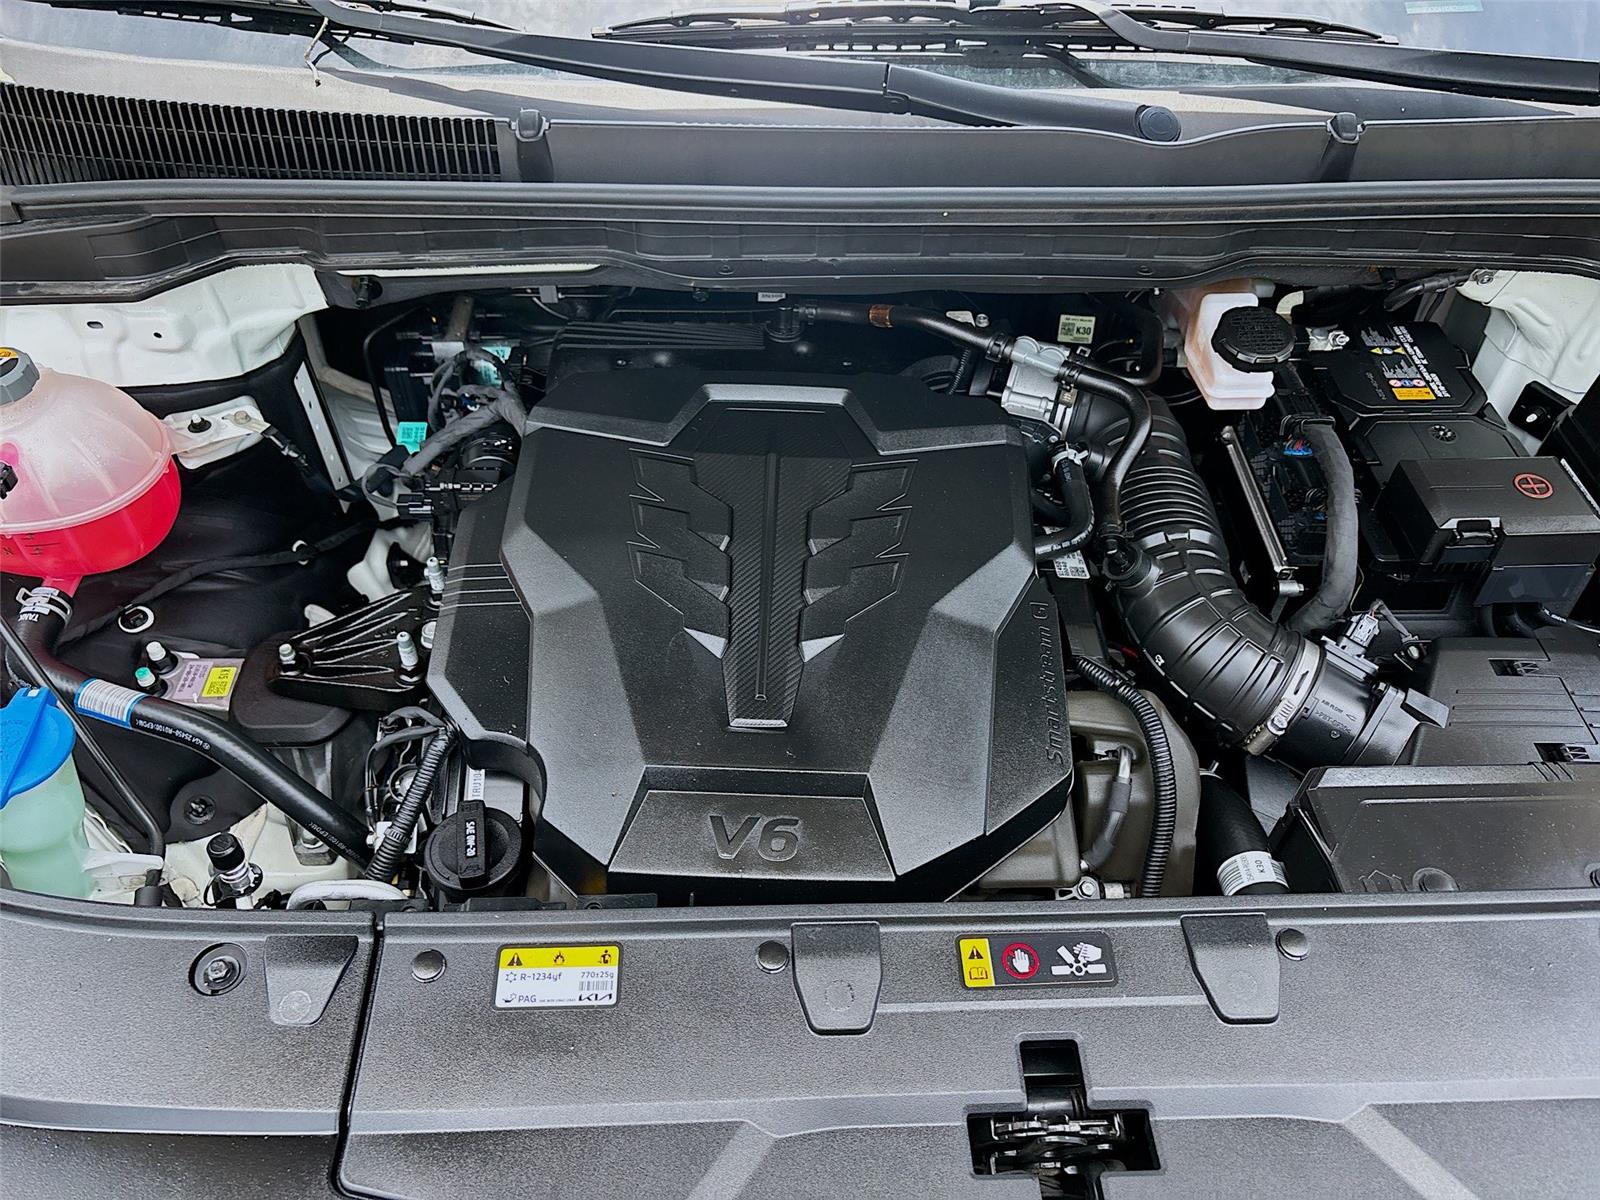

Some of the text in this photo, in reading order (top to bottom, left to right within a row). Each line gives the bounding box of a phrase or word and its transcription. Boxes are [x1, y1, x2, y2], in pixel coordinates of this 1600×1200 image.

[1075, 326, 1092, 336] K30
[17, 612, 39, 622] TANK
[1038, 625, 1064, 765] Smartstream
[466, 821, 476, 857] SAE 0W-20
[709, 815, 800, 861] V6
[520, 971, 614, 983] R-1234yf 770±25g
[518, 995, 537, 1003] PAG
[578, 993, 613, 1002] KIA
